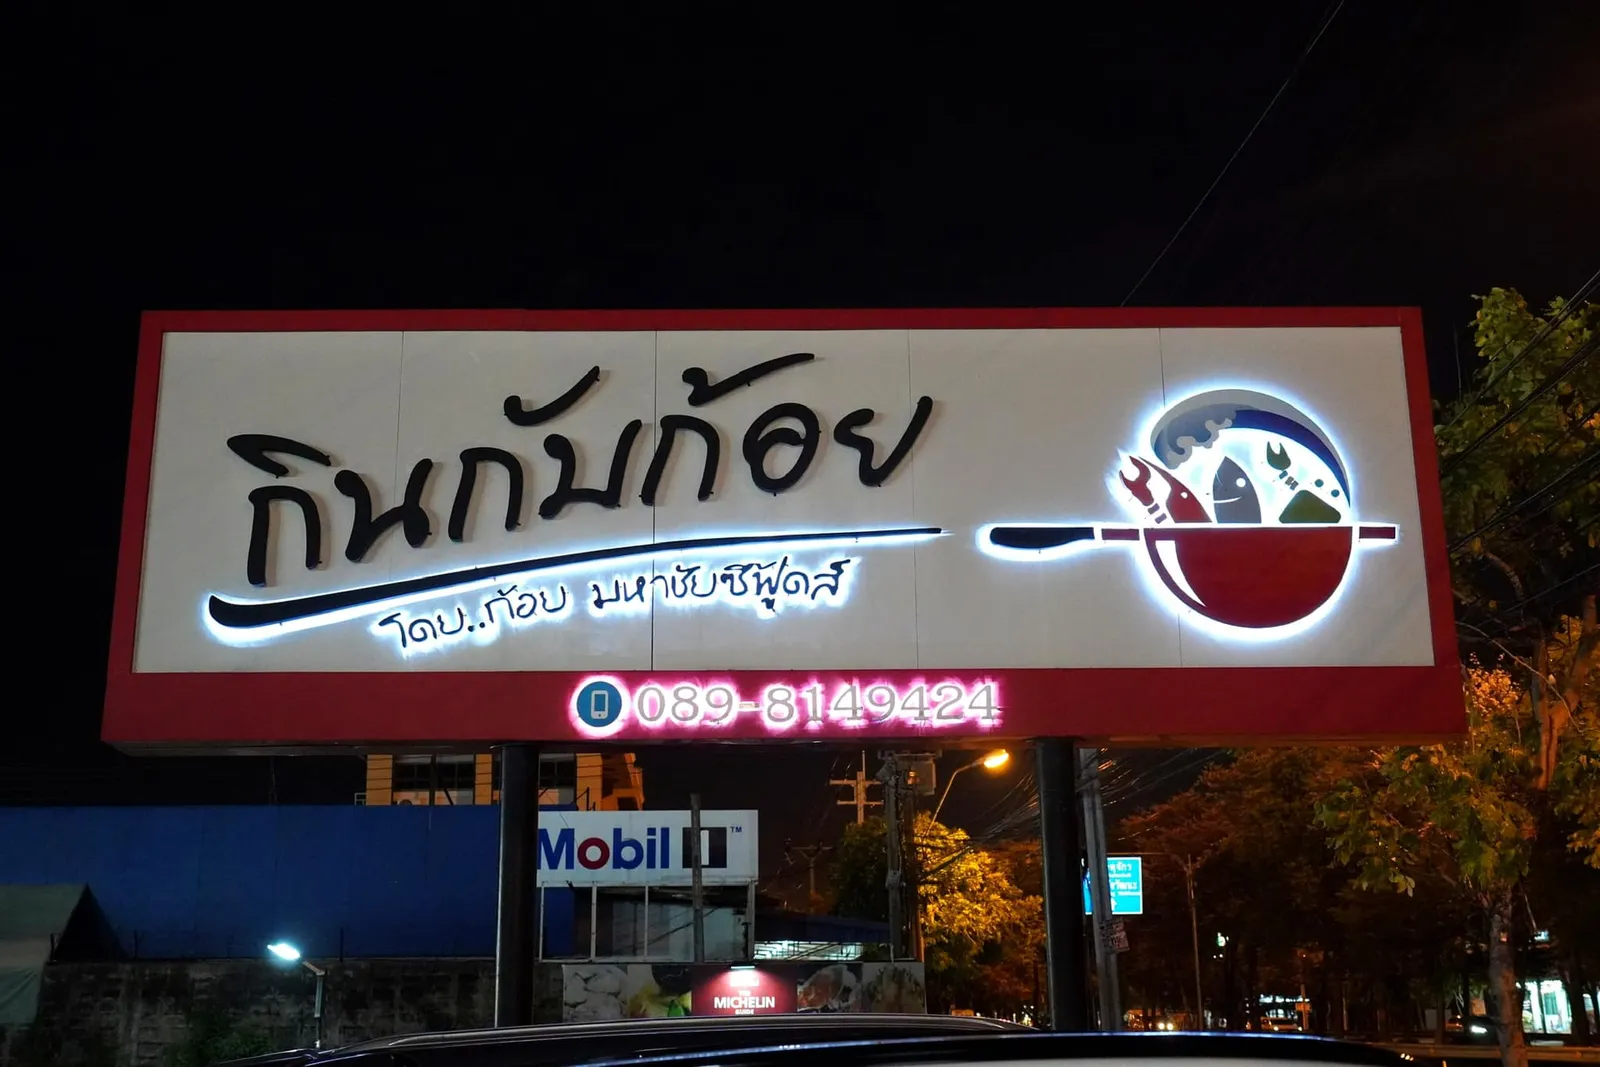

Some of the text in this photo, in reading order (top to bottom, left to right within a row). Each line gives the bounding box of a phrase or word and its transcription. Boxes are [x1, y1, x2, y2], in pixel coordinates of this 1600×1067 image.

[637, 684, 1000, 723] 089-8149424
[538, 827, 670, 870] Mobil
[713, 996, 776, 1009] MICHELIN
